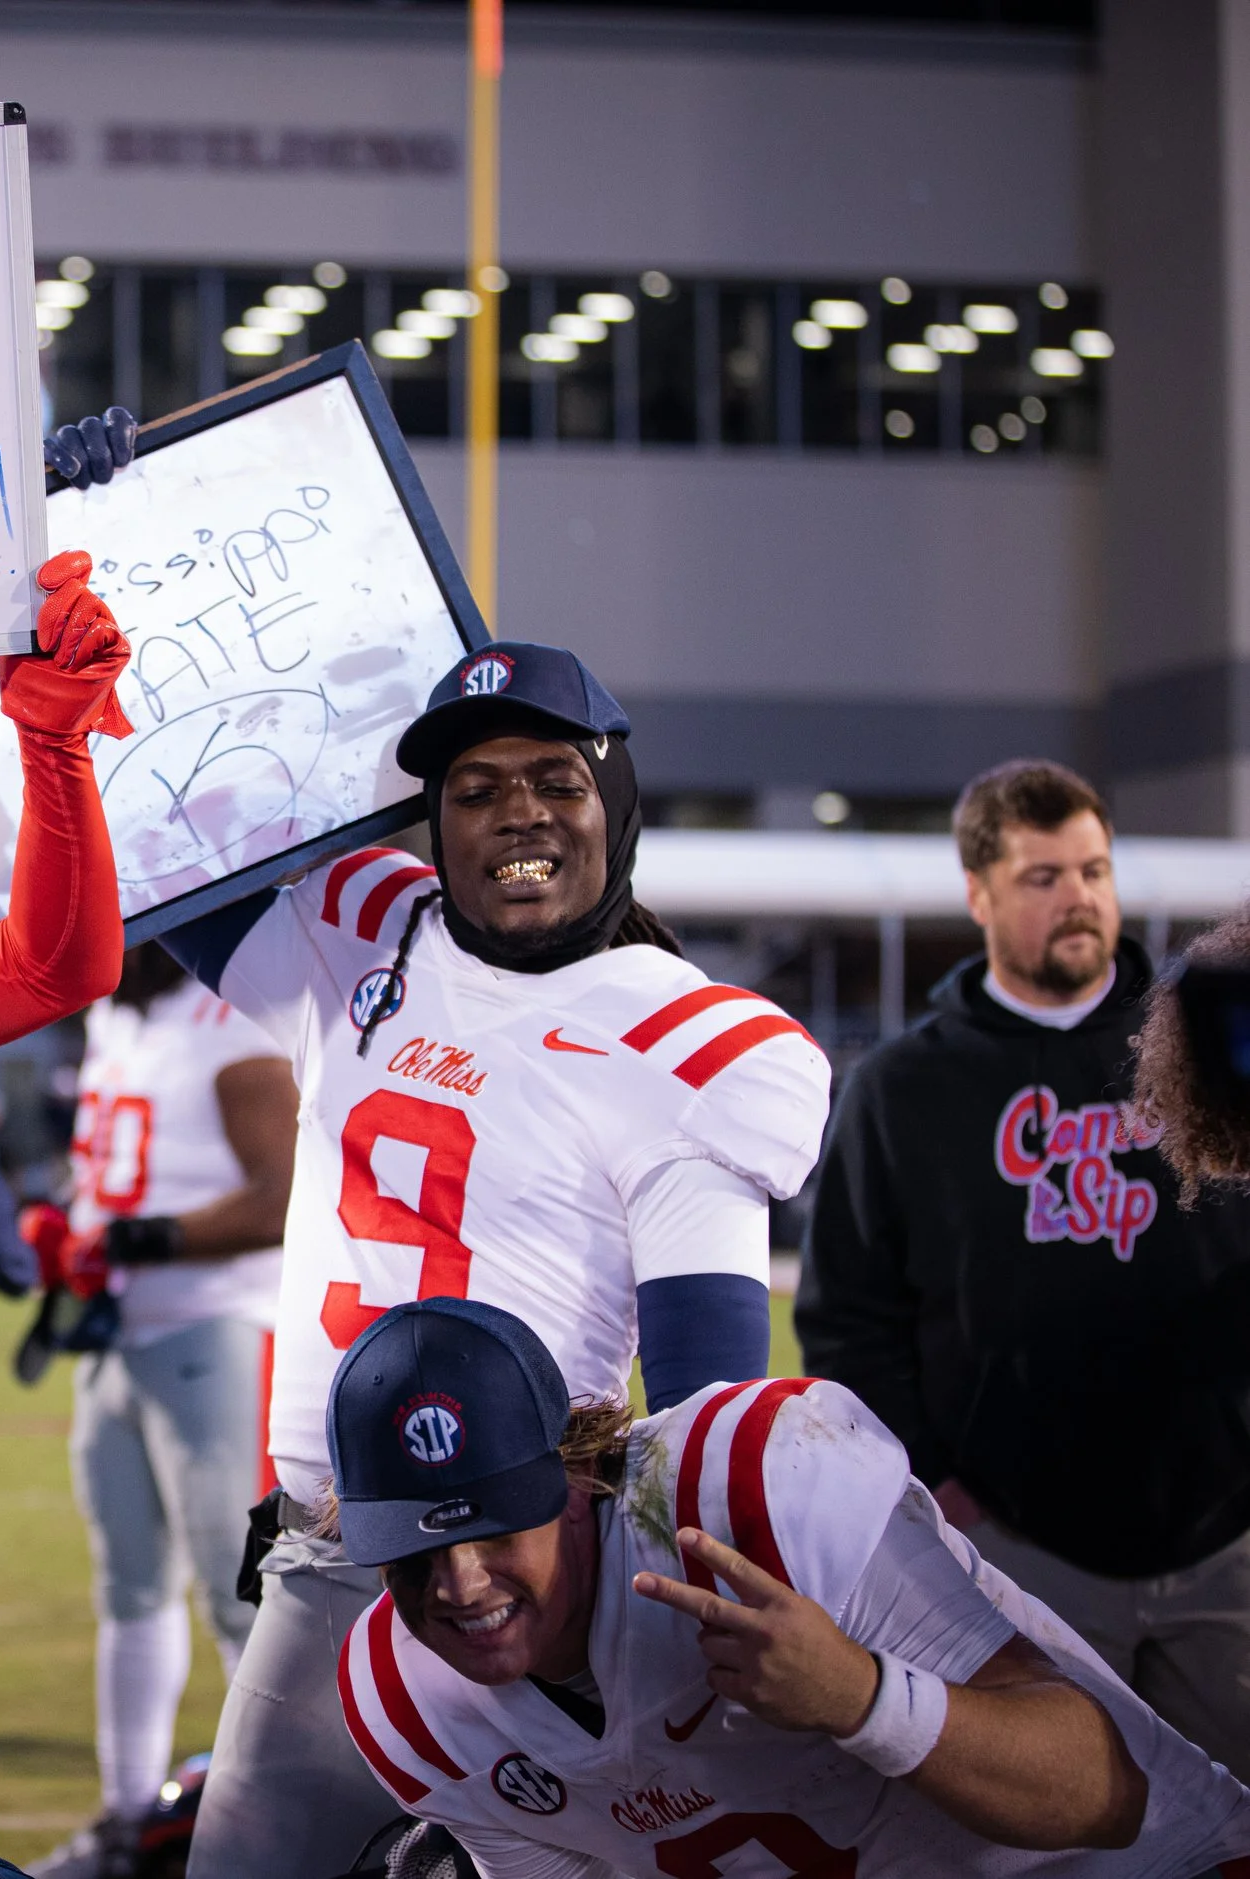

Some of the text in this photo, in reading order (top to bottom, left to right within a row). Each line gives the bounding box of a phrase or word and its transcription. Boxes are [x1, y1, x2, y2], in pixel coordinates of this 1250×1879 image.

[88, 487, 334, 598] issippi
[126, 592, 318, 724] ATE
[465, 660, 508, 696] SIP
[387, 1036, 489, 1098] Ole Miss
[321, 1088, 478, 1350] 9
[1062, 1154, 1158, 1261] Sip
[404, 1406, 459, 1463] SIP
[498, 1759, 562, 1812] SEC
[636, 1786, 716, 1828] Miss
